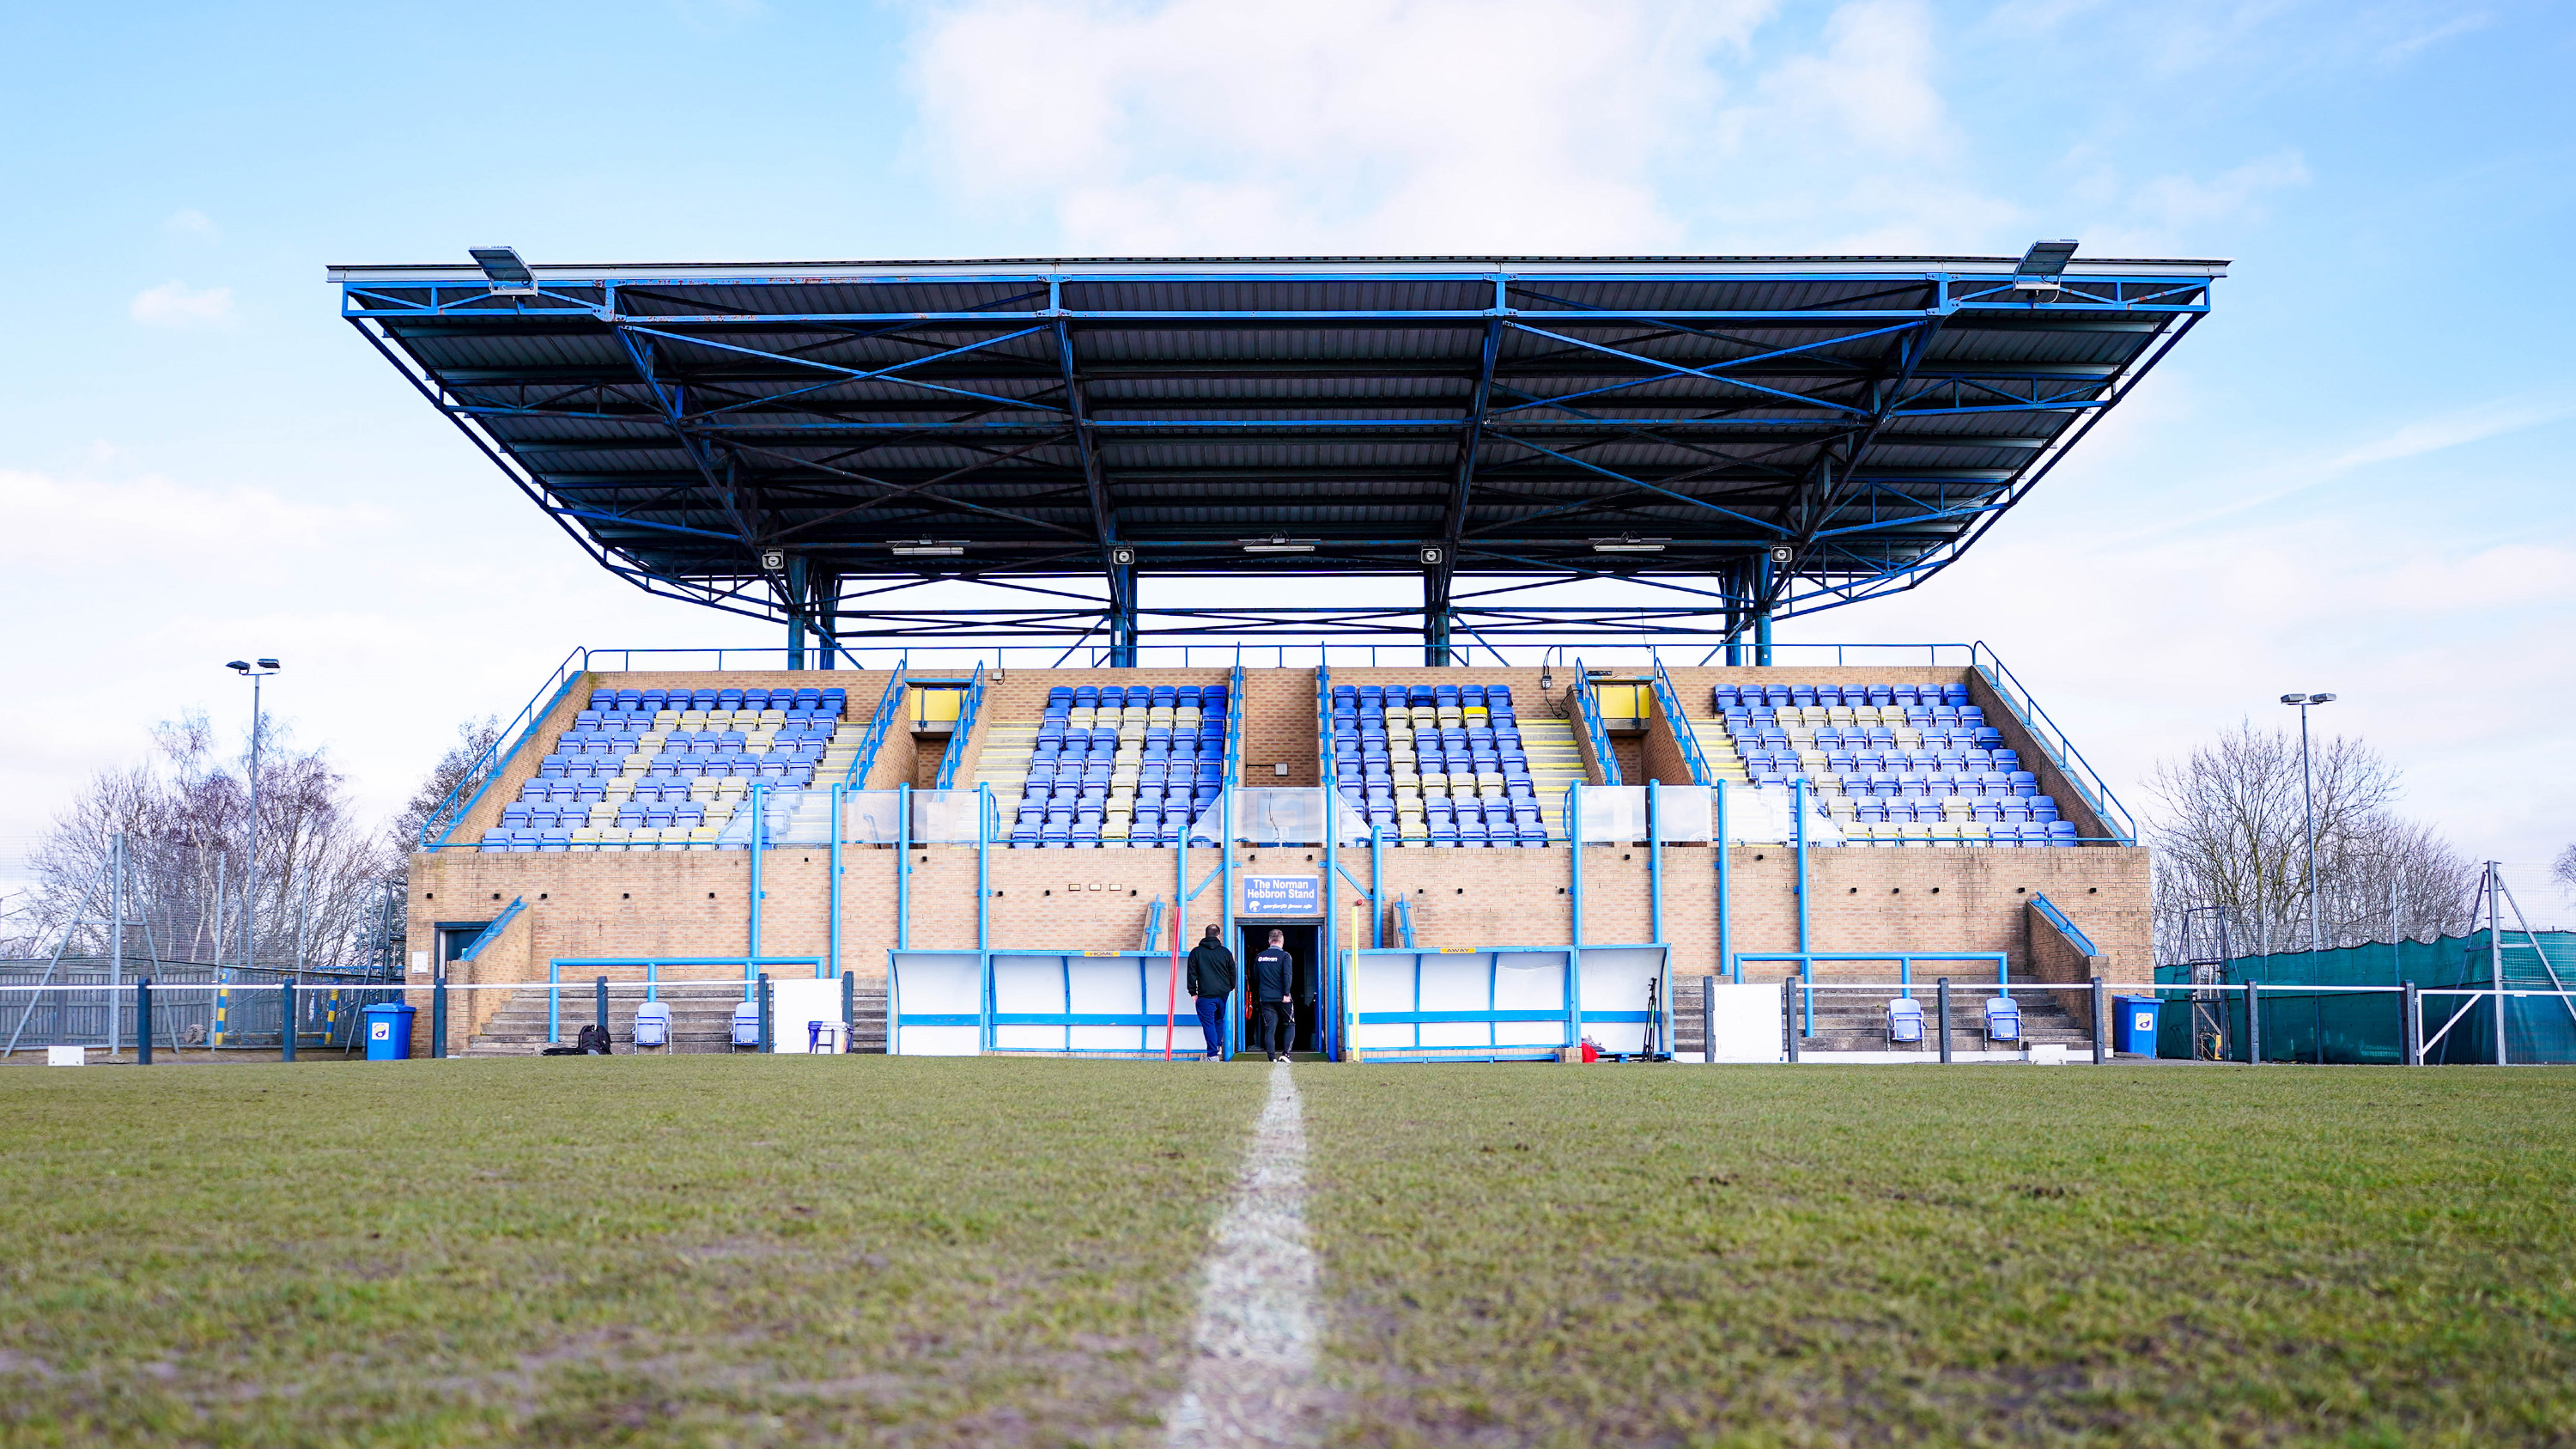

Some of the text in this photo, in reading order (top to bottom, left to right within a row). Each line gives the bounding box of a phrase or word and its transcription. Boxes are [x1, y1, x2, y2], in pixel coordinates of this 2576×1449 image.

[1253, 879, 1309, 889] The Norman
[1247, 888, 1315, 898] Hebbron Stand
